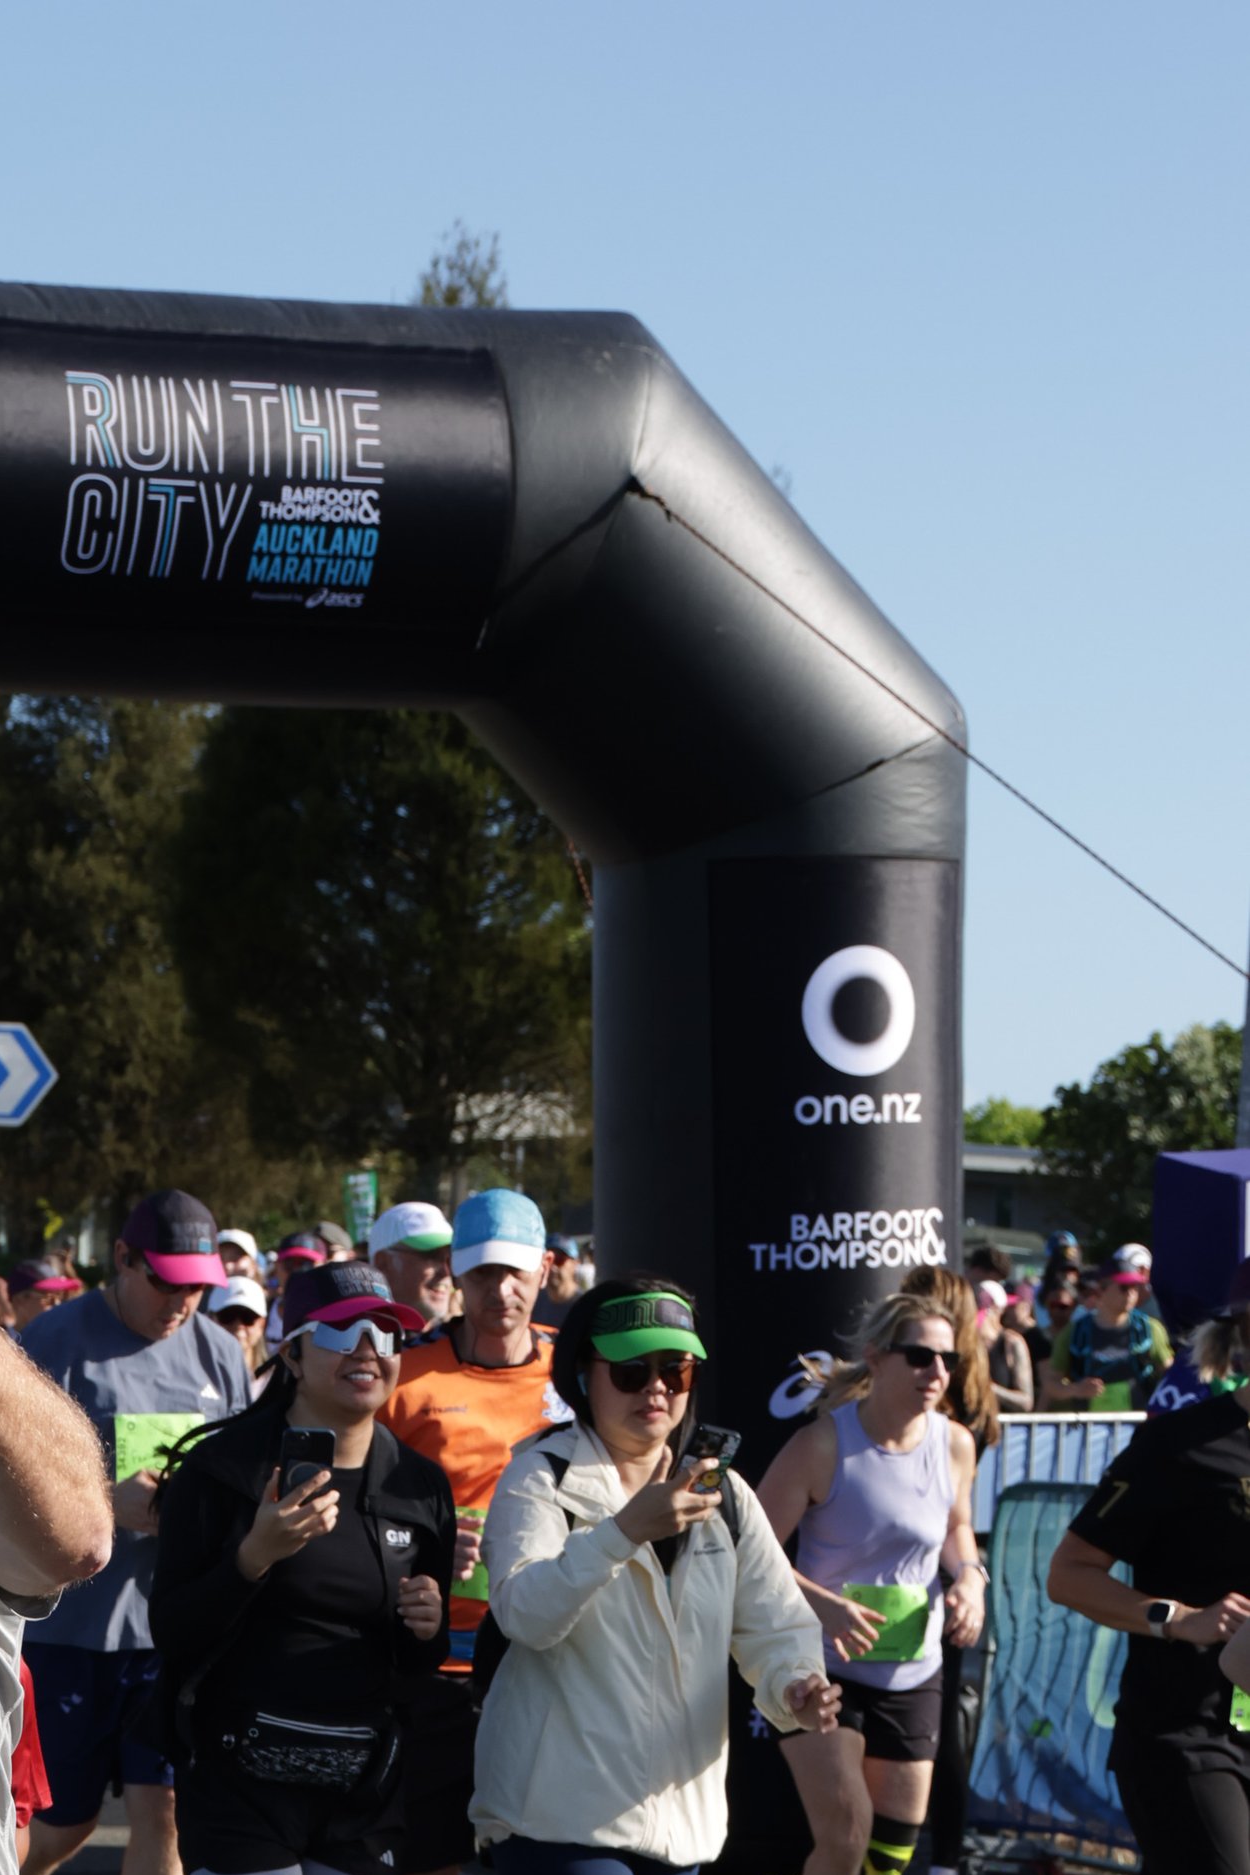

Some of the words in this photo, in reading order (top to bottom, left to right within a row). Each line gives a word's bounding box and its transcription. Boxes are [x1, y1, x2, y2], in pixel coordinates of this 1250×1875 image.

[65, 370, 225, 472] RUN
[229, 380, 385, 484] THE
[60, 472, 254, 581] CITY
[252, 522, 380, 559] AUCKLAND
[246, 556, 374, 587] MARATHON
[794, 1092, 923, 1126] one.nz
[748, 1237, 924, 1271] THOMPSON
[385, 1529, 411, 1545] GN
